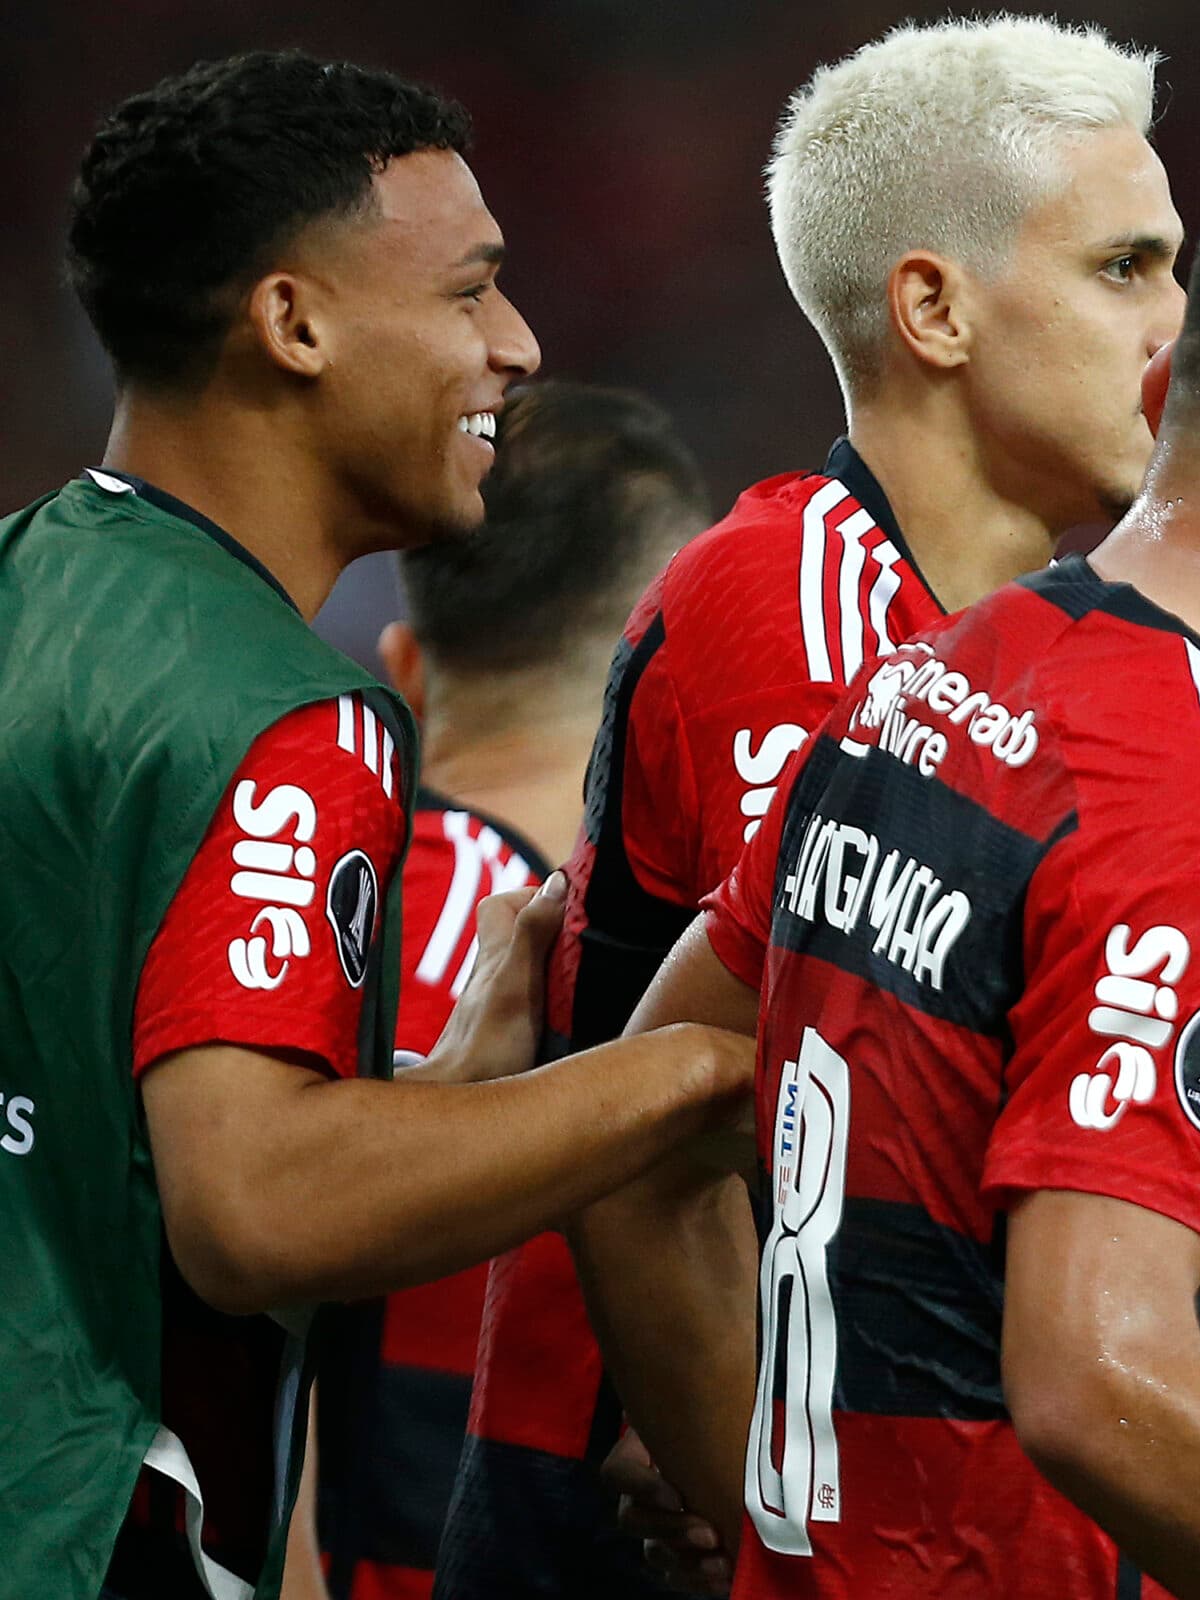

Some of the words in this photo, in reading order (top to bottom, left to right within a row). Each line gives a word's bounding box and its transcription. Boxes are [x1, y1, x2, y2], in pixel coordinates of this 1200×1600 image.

[901, 657, 1039, 768] merado
[0, 1091, 35, 1156] S
[780, 1082, 799, 1158] TIM
